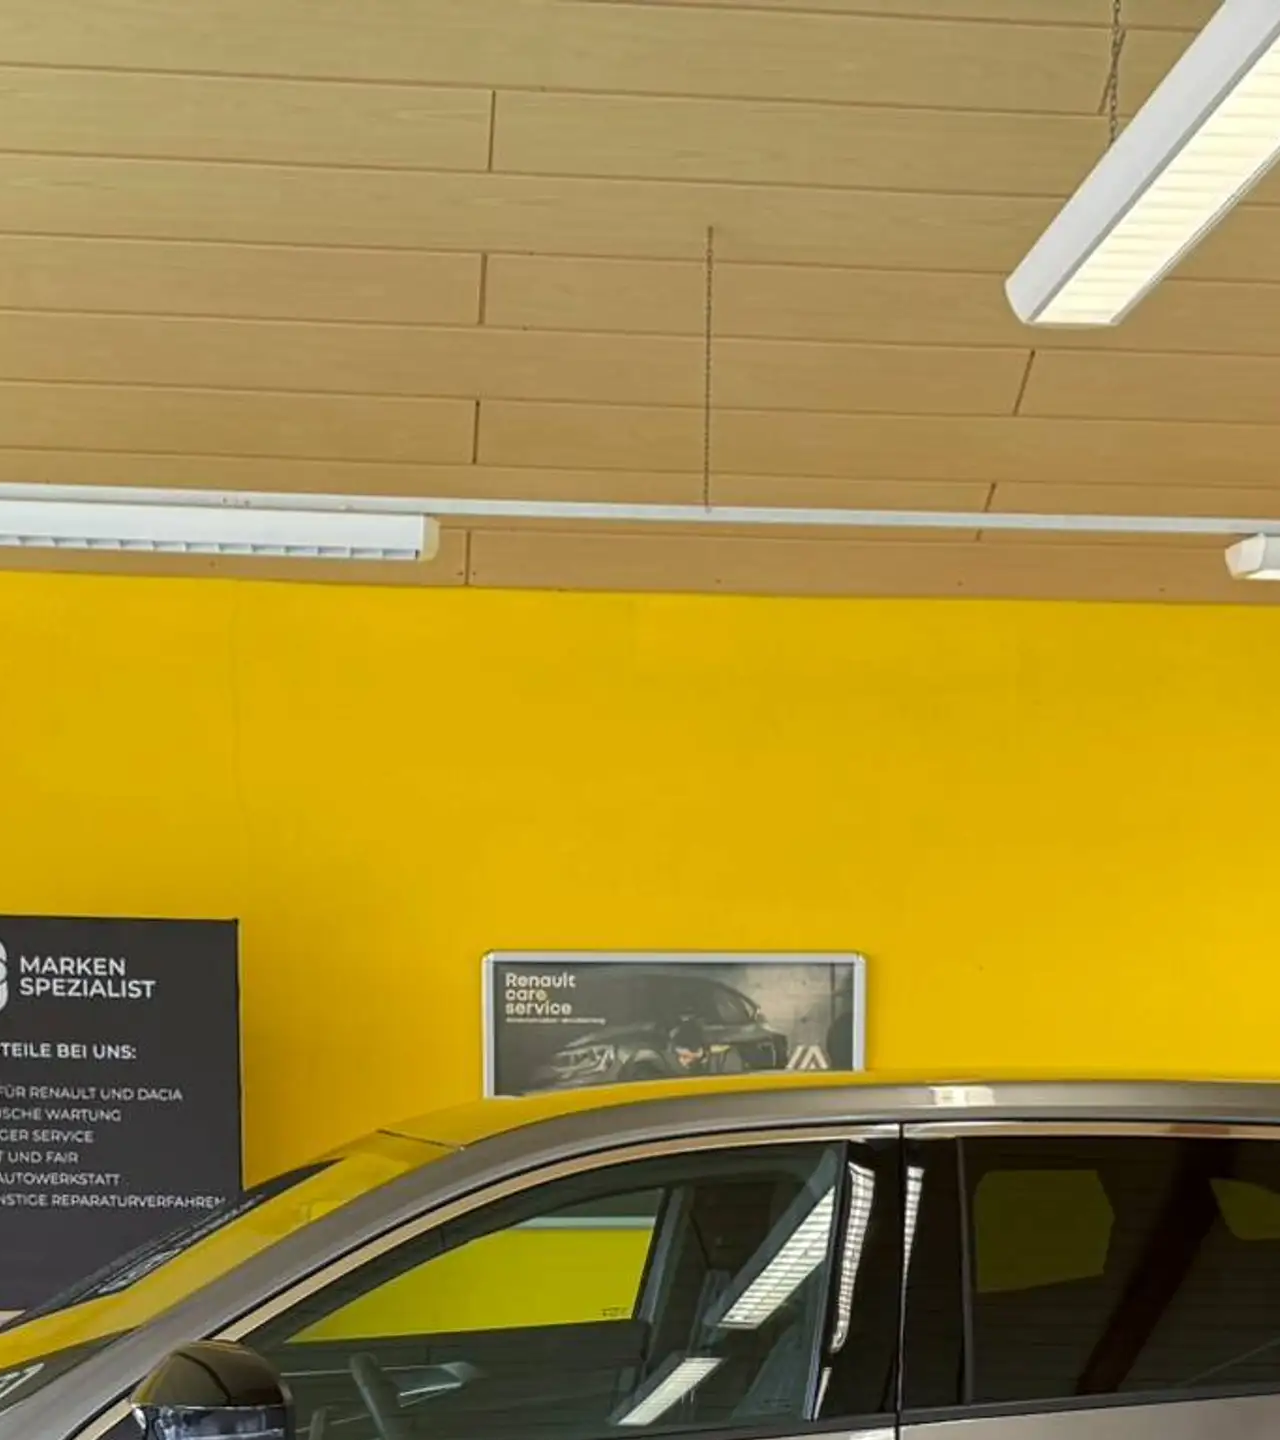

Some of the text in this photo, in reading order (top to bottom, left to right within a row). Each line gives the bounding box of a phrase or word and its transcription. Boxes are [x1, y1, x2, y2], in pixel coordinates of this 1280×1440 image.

[20, 956, 126, 976] MARKEN
[505, 972, 576, 988] Renault
[19, 978, 155, 999] SPEZIALIST
[505, 989, 548, 1001] care
[505, 1000, 572, 1015] service
[57, 1044, 87, 1059] BEI
[94, 1044, 137, 1060] UNS:
[29, 1086, 96, 1100] RENAULT
[100, 1088, 134, 1101] UND
[137, 1088, 183, 1101] DACIA
[46, 1109, 121, 1123] WARTUNG
[32, 1130, 94, 1143] SERVICE
[8, 1151, 42, 1163] UND
[46, 1152, 78, 1164] FAIR
